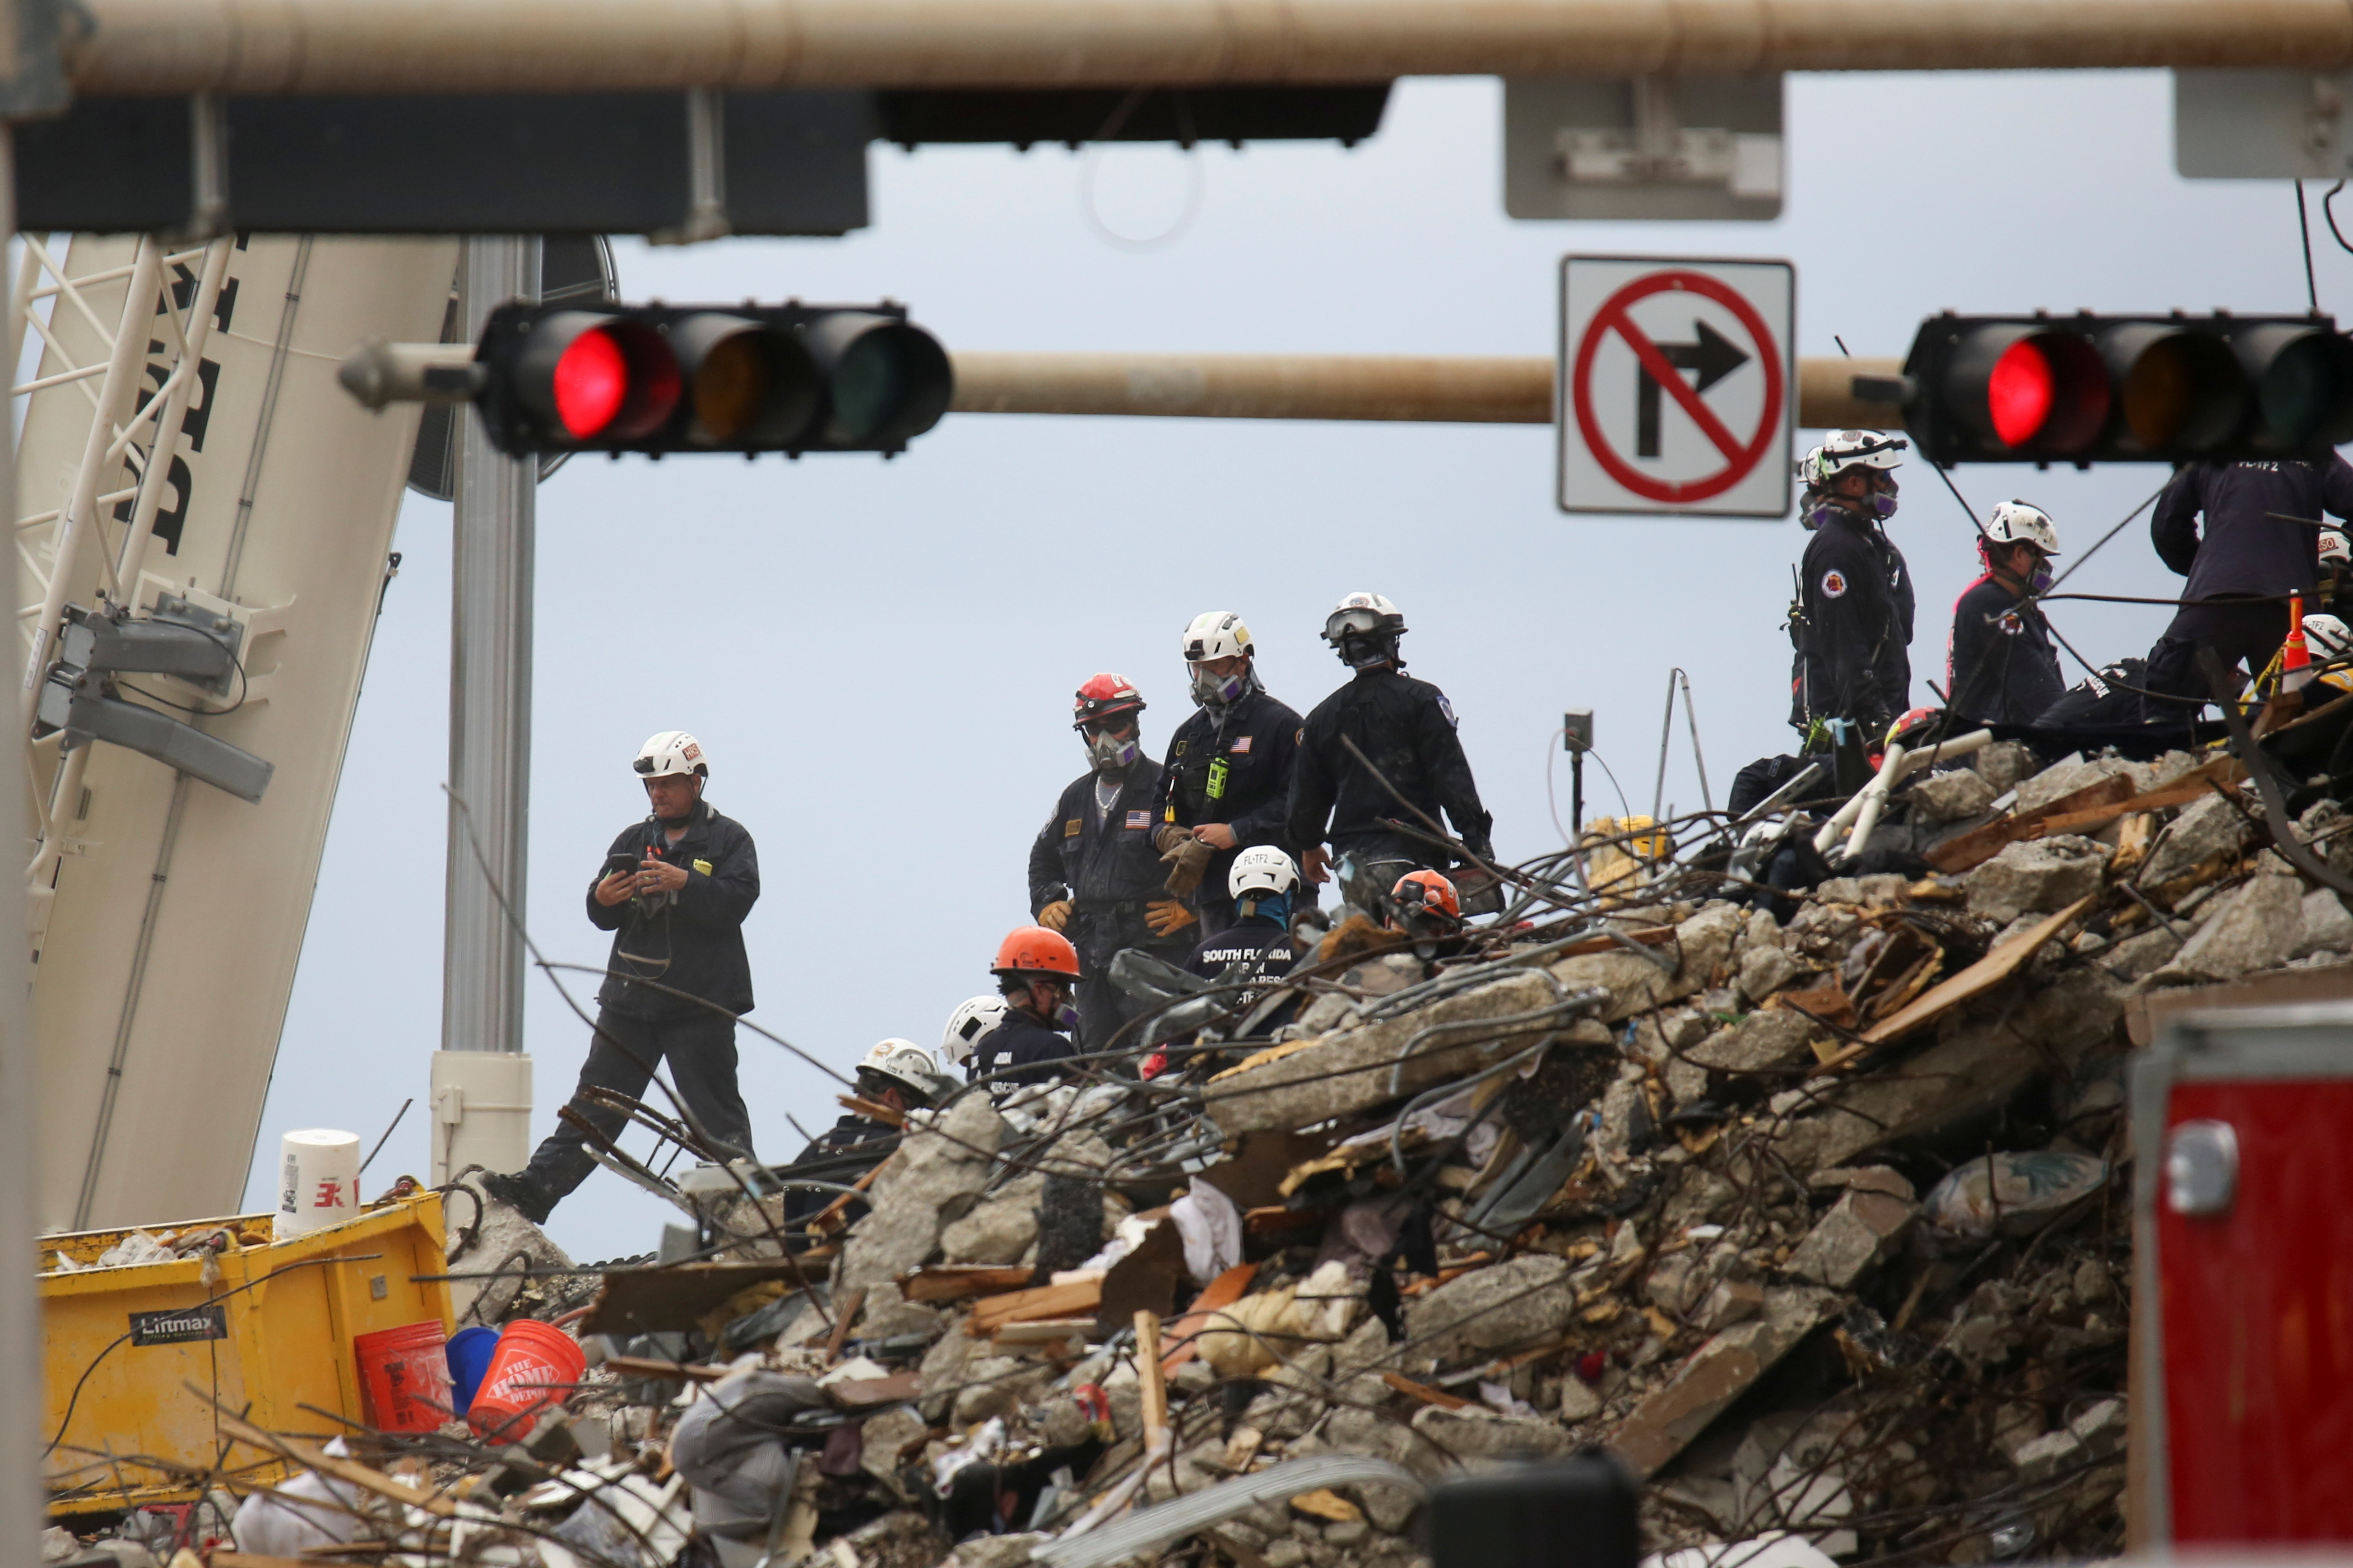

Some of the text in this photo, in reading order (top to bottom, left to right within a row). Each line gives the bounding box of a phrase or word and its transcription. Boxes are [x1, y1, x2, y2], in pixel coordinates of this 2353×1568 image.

[113, 231, 250, 556] BEY
[685, 744, 699, 759] HRS
[1203, 948, 1242, 963] SOUTH
[505, 1359, 533, 1375] THE
[492, 1365, 555, 1398] HOME
